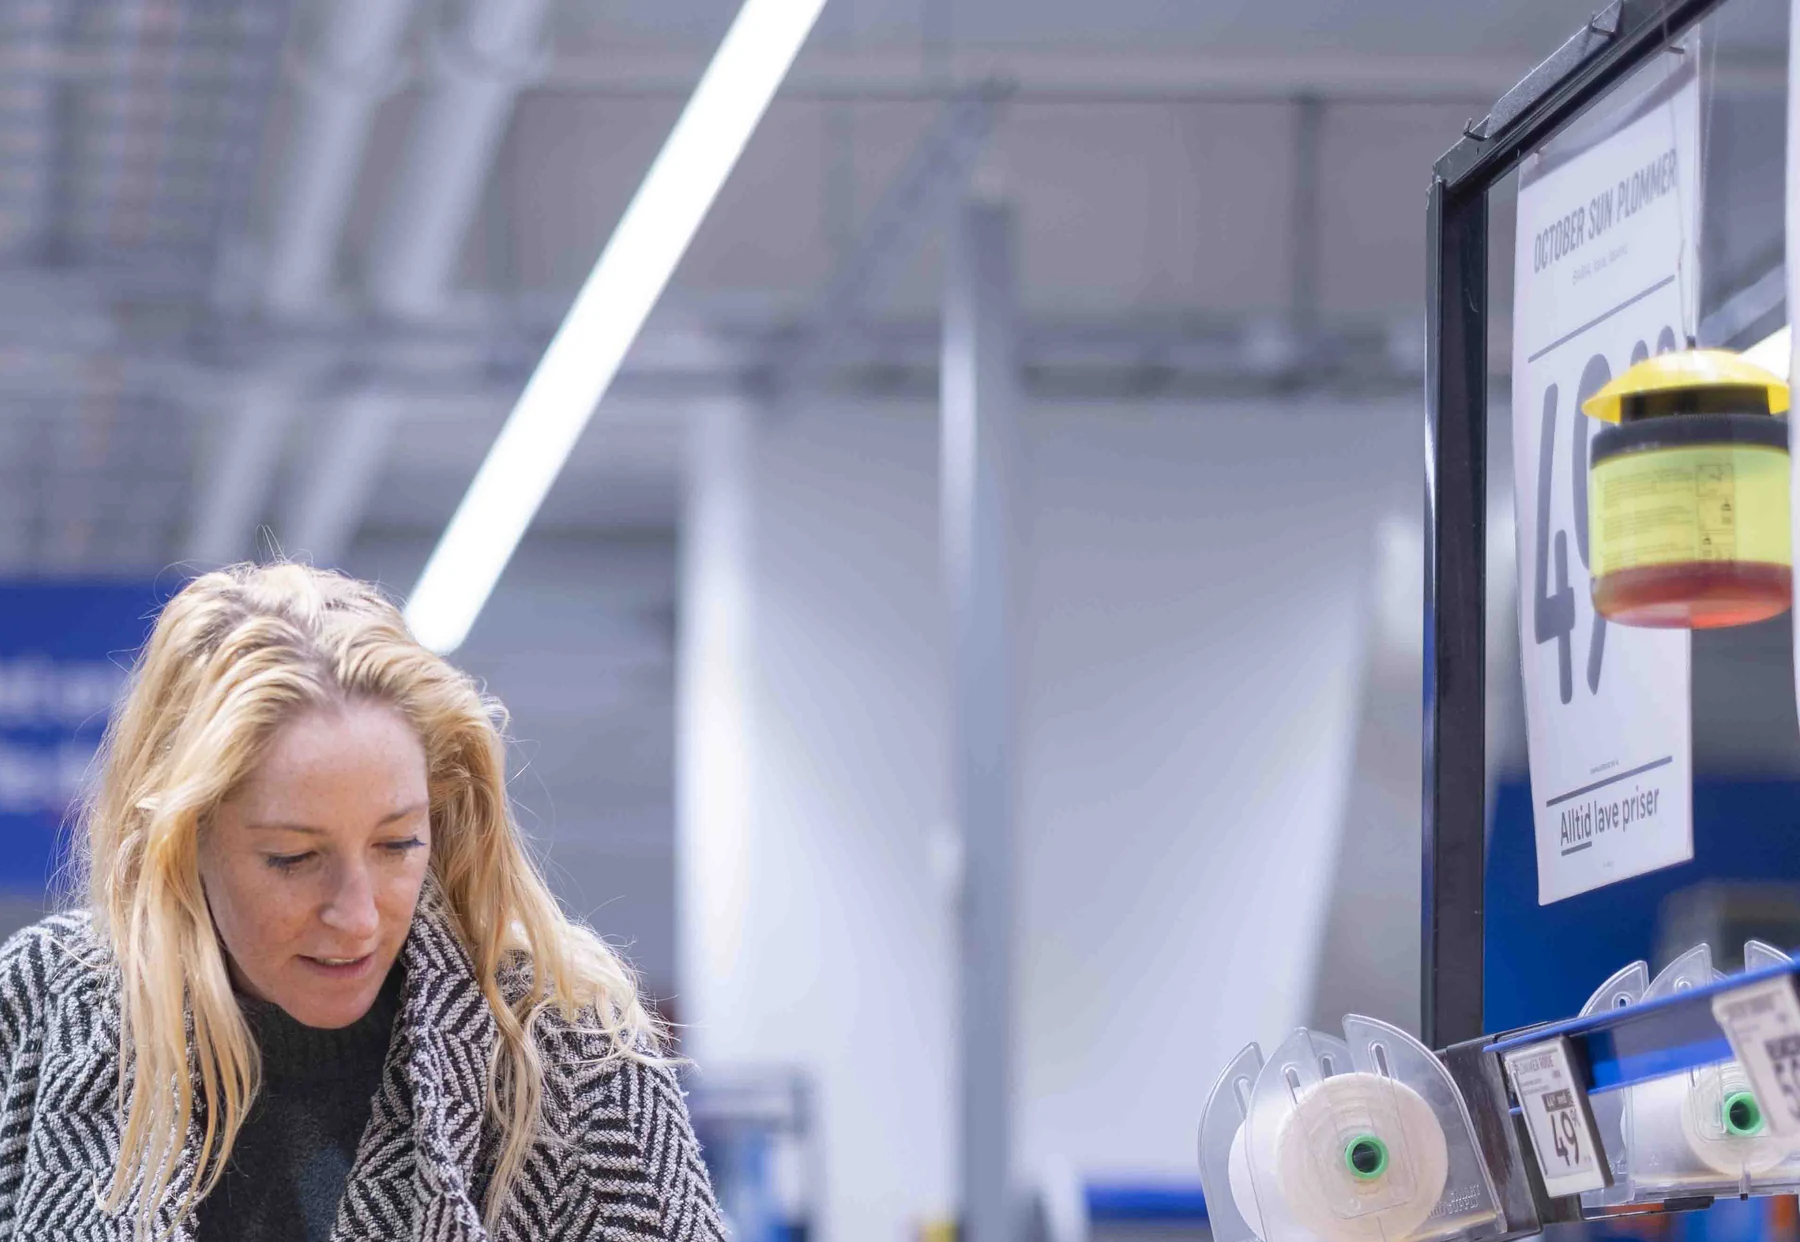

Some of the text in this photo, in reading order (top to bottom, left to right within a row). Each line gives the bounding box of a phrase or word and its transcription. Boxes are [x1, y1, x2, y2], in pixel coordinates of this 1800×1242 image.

[1534, 206, 1585, 274] OCTOBER
[1588, 186, 1614, 240] SUN
[1617, 148, 1678, 222] PLOMMER
[1560, 784, 1660, 847] Alltid lave priser
[1550, 1110, 1579, 1167] 49
